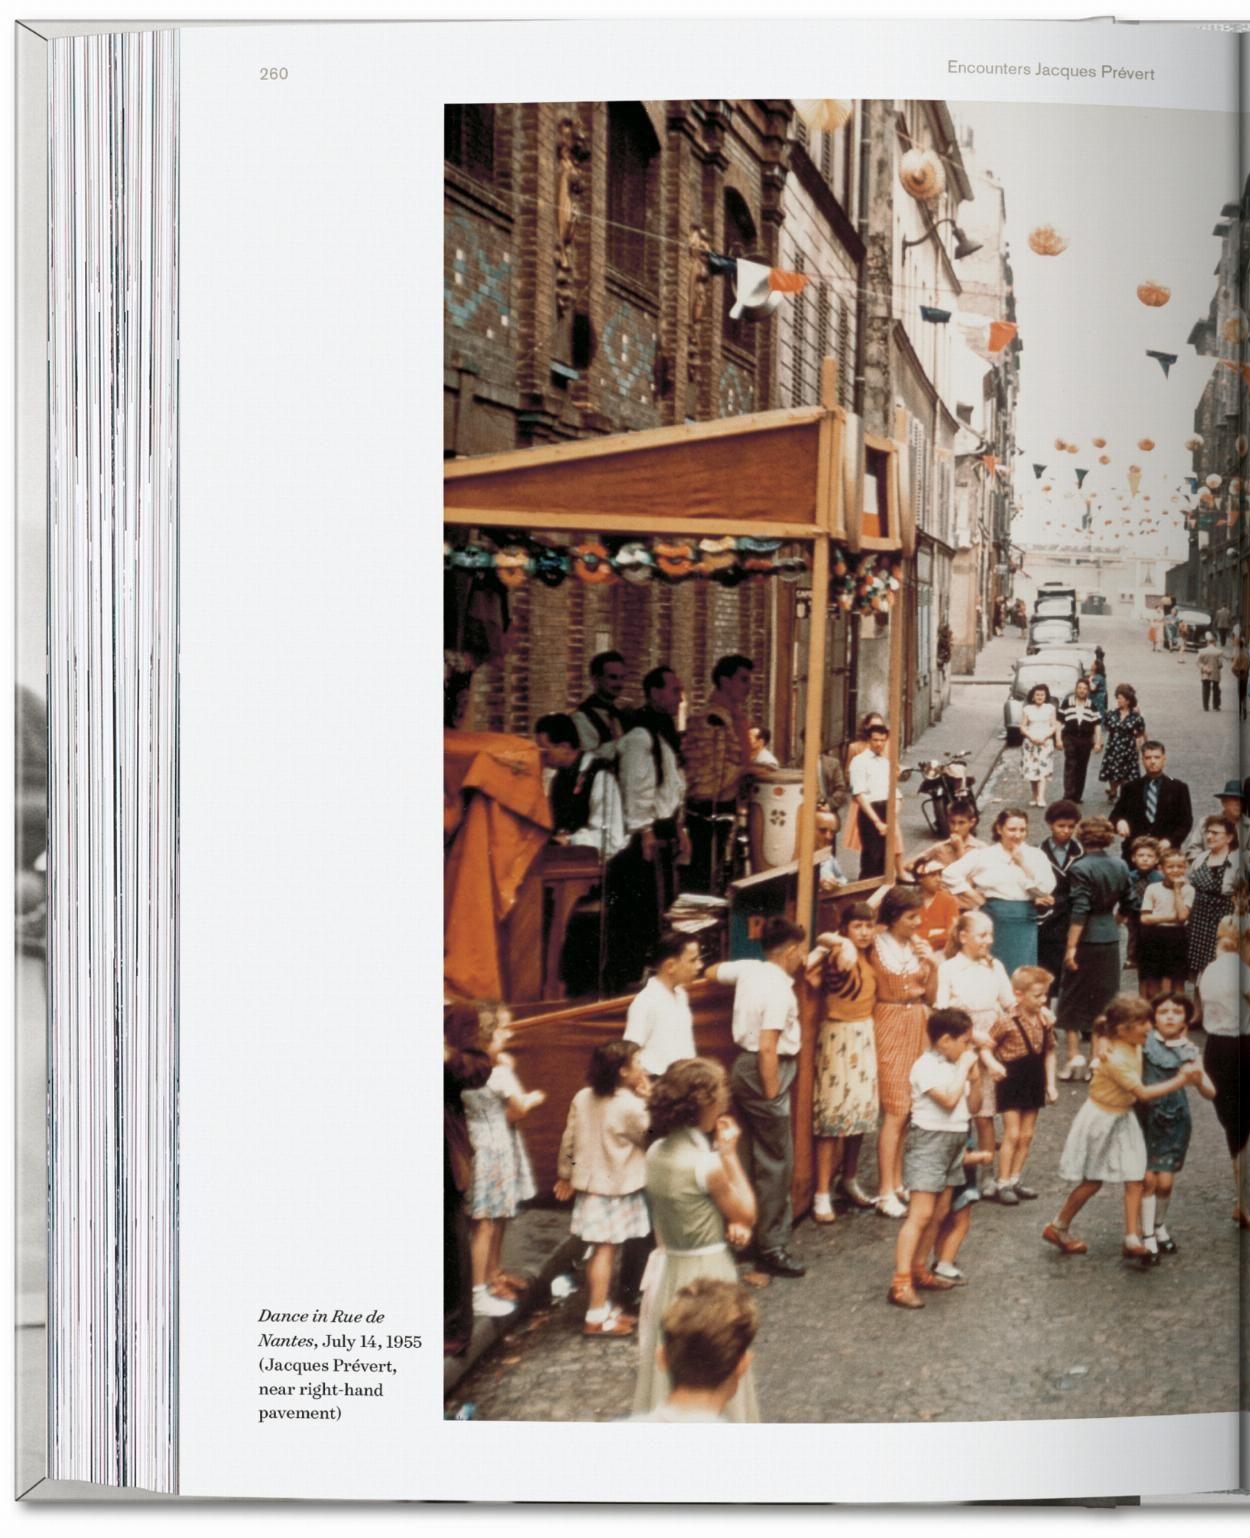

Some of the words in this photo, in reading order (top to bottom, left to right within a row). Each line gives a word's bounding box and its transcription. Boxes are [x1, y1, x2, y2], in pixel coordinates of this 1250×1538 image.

[259, 66, 289, 81] 260
[948, 59, 1031, 76] Encounters
[1035, 62, 1097, 81] Jacques
[1101, 64, 1156, 81] Prévert
[257, 1308, 309, 1324] Dance
[312, 1308, 328, 1324] in
[330, 1308, 363, 1324] Rue
[365, 1309, 386, 1324] de
[256, 1333, 319, 1351] Nantes,
[321, 1333, 357, 1353] July
[359, 1334, 383, 1352] 14,
[386, 1334, 423, 1349] 1955
[258, 1356, 330, 1377] (Jacques
[332, 1357, 398, 1376] Prévert,
[258, 1385, 296, 1397] near
[298, 1381, 384, 1401] right-hand
[258, 1405, 342, 1424] pavement)
